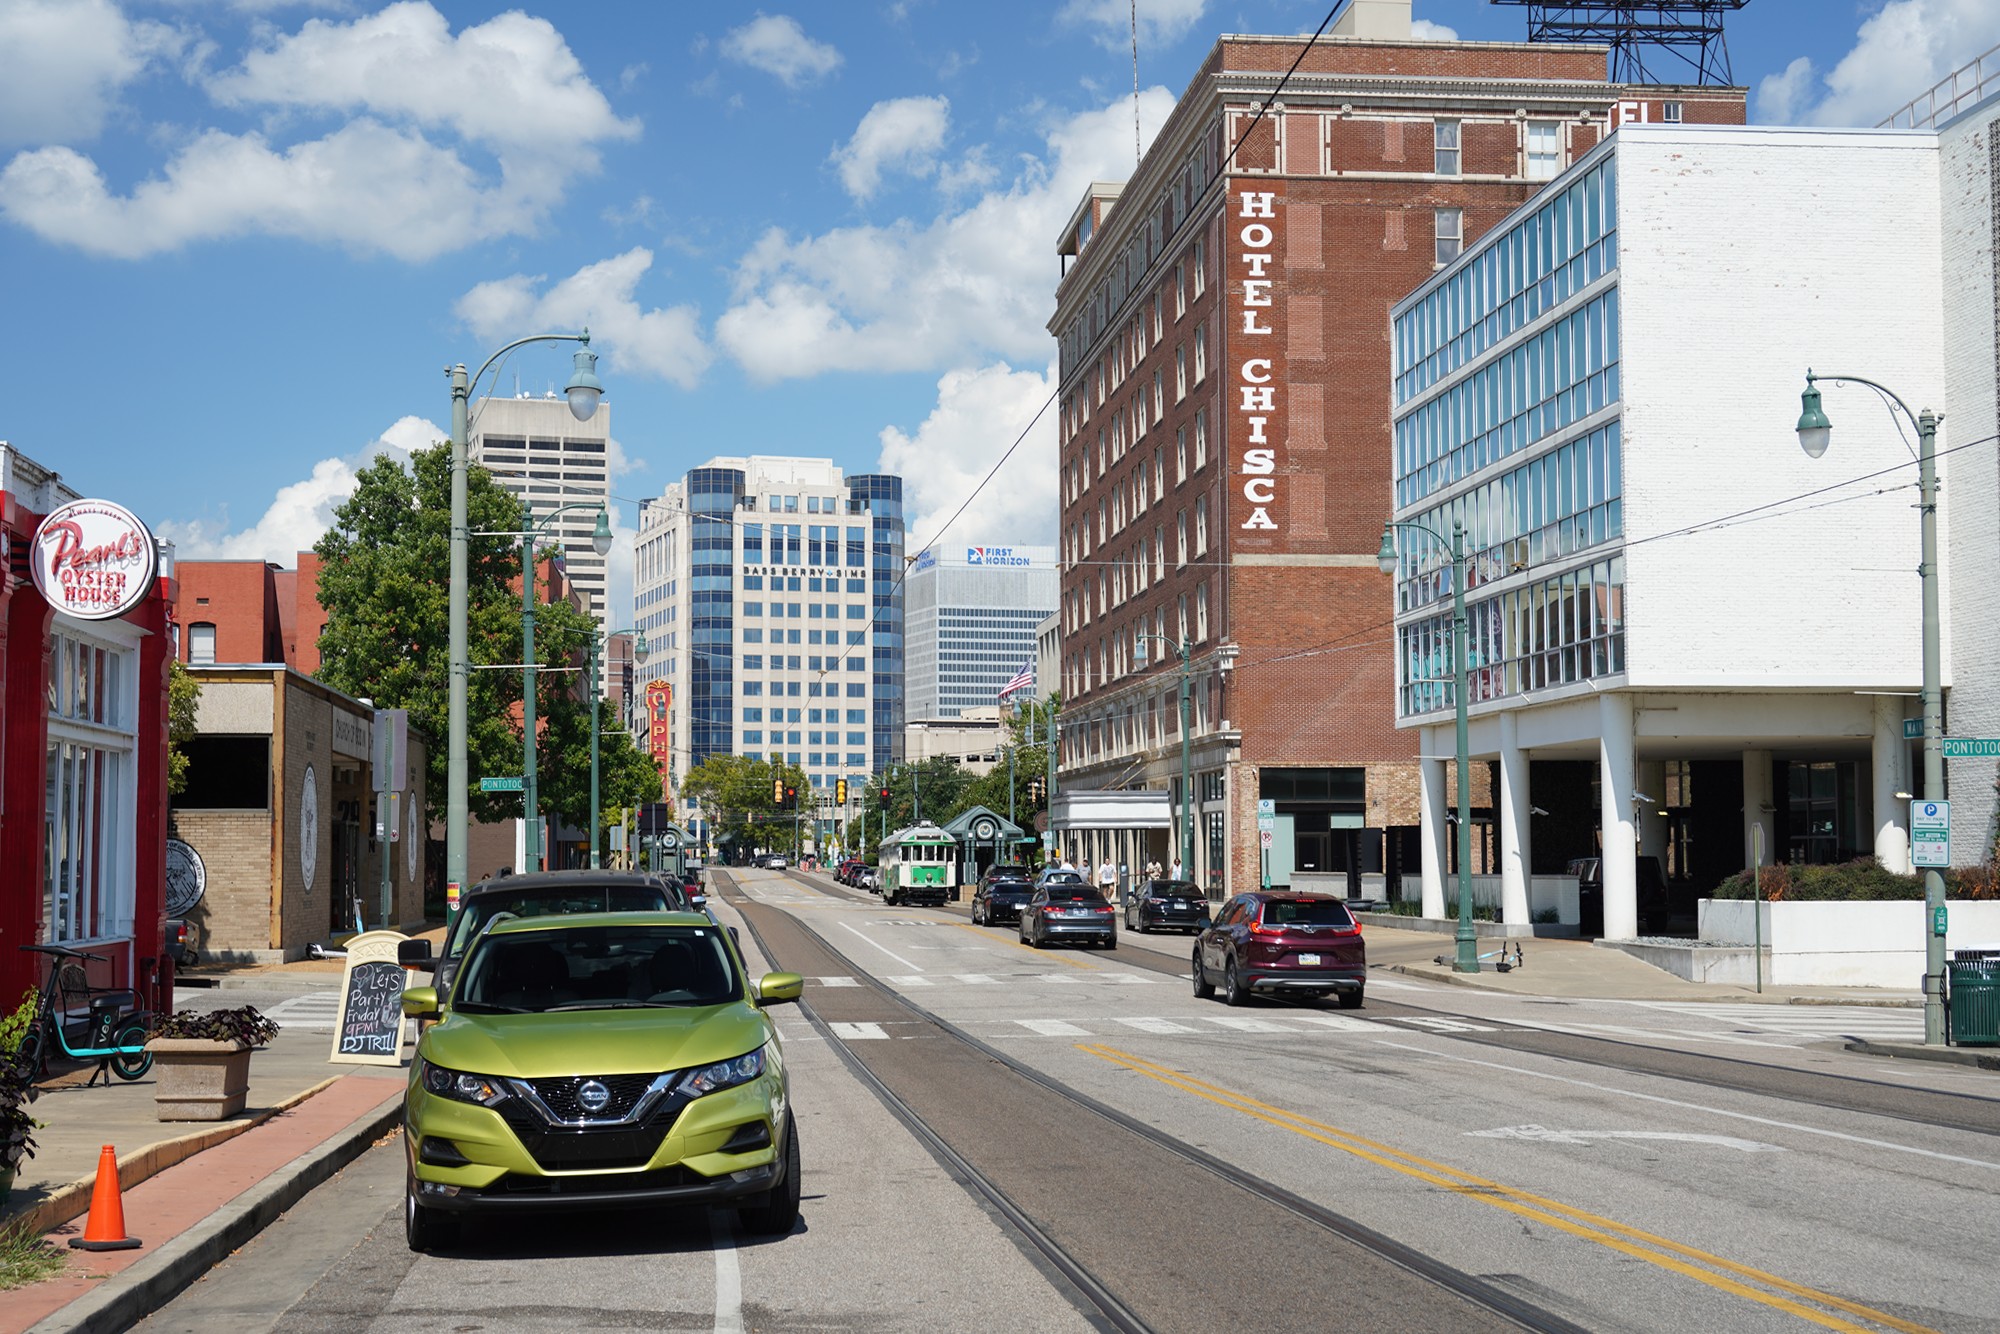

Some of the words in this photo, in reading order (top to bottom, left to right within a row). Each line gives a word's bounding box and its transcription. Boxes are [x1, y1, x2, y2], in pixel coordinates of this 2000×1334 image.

[1240, 192, 1275, 334] HOTEL
[1240, 359, 1278, 529] CHISCA
[43, 520, 141, 576] Pearl's
[986, 548, 1013, 557] FIRST
[986, 557, 1030, 566] HORIZON
[61, 569, 126, 588] OYSTER
[743, 566, 776, 576] BASS
[782, 567, 824, 577] BERRY
[836, 569, 866, 578] SIMS
[64, 586, 120, 604] HOUSE
[482, 780, 522, 789] PONTOTOC
[350, 989, 386, 1007] Party
[346, 1007, 381, 1023] Friday
[341, 1035, 366, 1052] DJ
